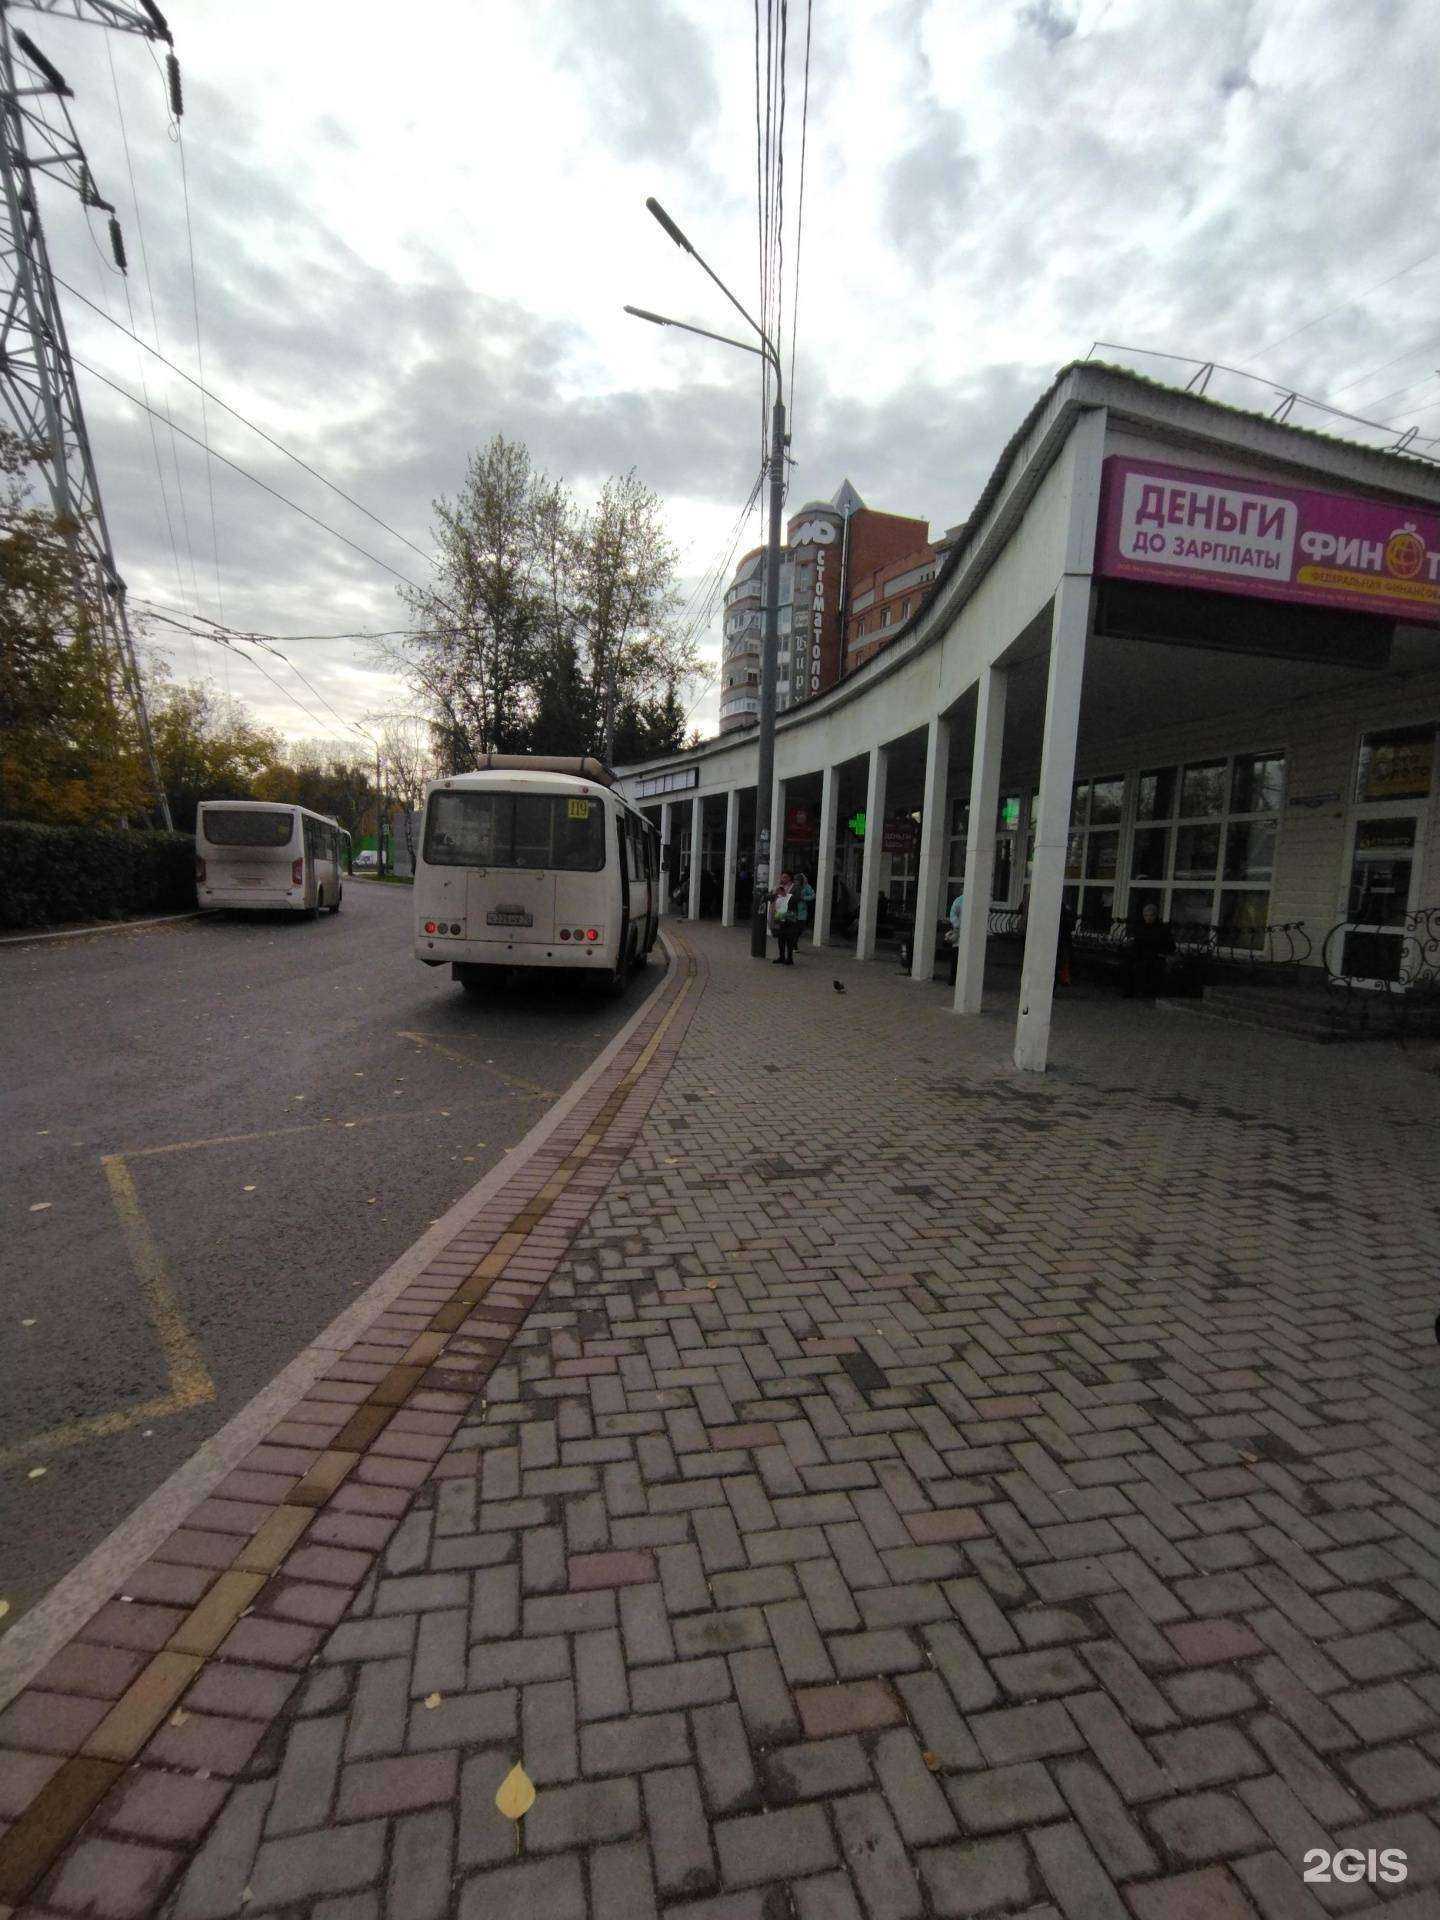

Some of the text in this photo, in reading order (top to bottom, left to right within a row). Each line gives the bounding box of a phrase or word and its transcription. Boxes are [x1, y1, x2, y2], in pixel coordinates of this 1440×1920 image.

[1135, 483, 1286, 541] ДЕНЬГИ
[1132, 531, 1281, 570] ДО ЗАРПЛАТЫ
